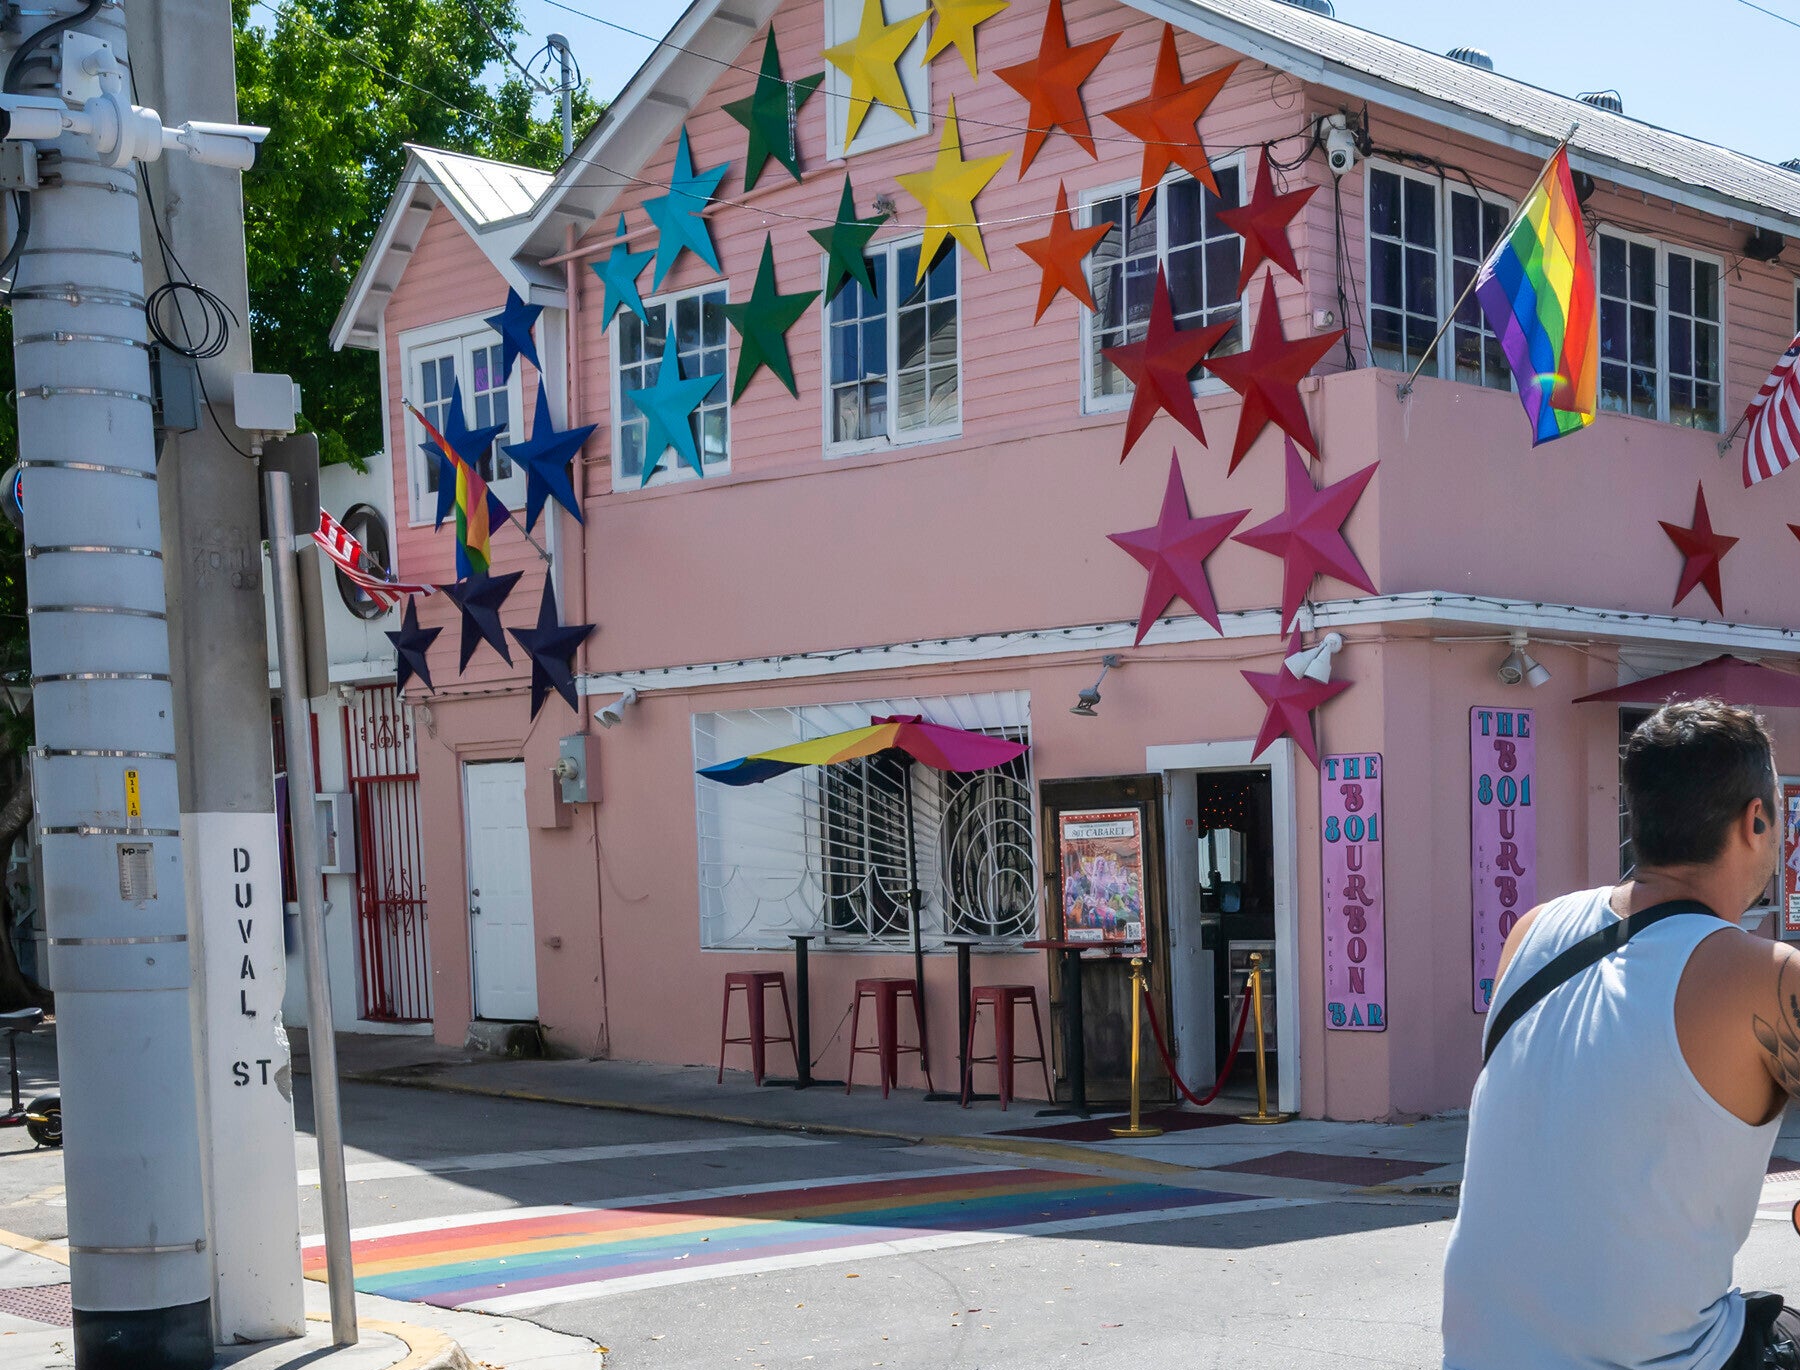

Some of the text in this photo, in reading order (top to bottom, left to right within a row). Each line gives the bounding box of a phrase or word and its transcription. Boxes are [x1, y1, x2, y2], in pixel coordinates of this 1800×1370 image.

[1478, 711, 1530, 738] THE
[1325, 757, 1378, 780] THE
[1478, 773, 1531, 808] 801
[1086, 826, 1126, 837] CABARET
[1325, 812, 1379, 843] 801
[1494, 739, 1526, 950] BOURBO
[1340, 783, 1374, 995] BOURBON
[233, 847, 256, 1019] DUVAL
[1327, 1002, 1385, 1027] BAR
[232, 1059, 272, 1087] ST
